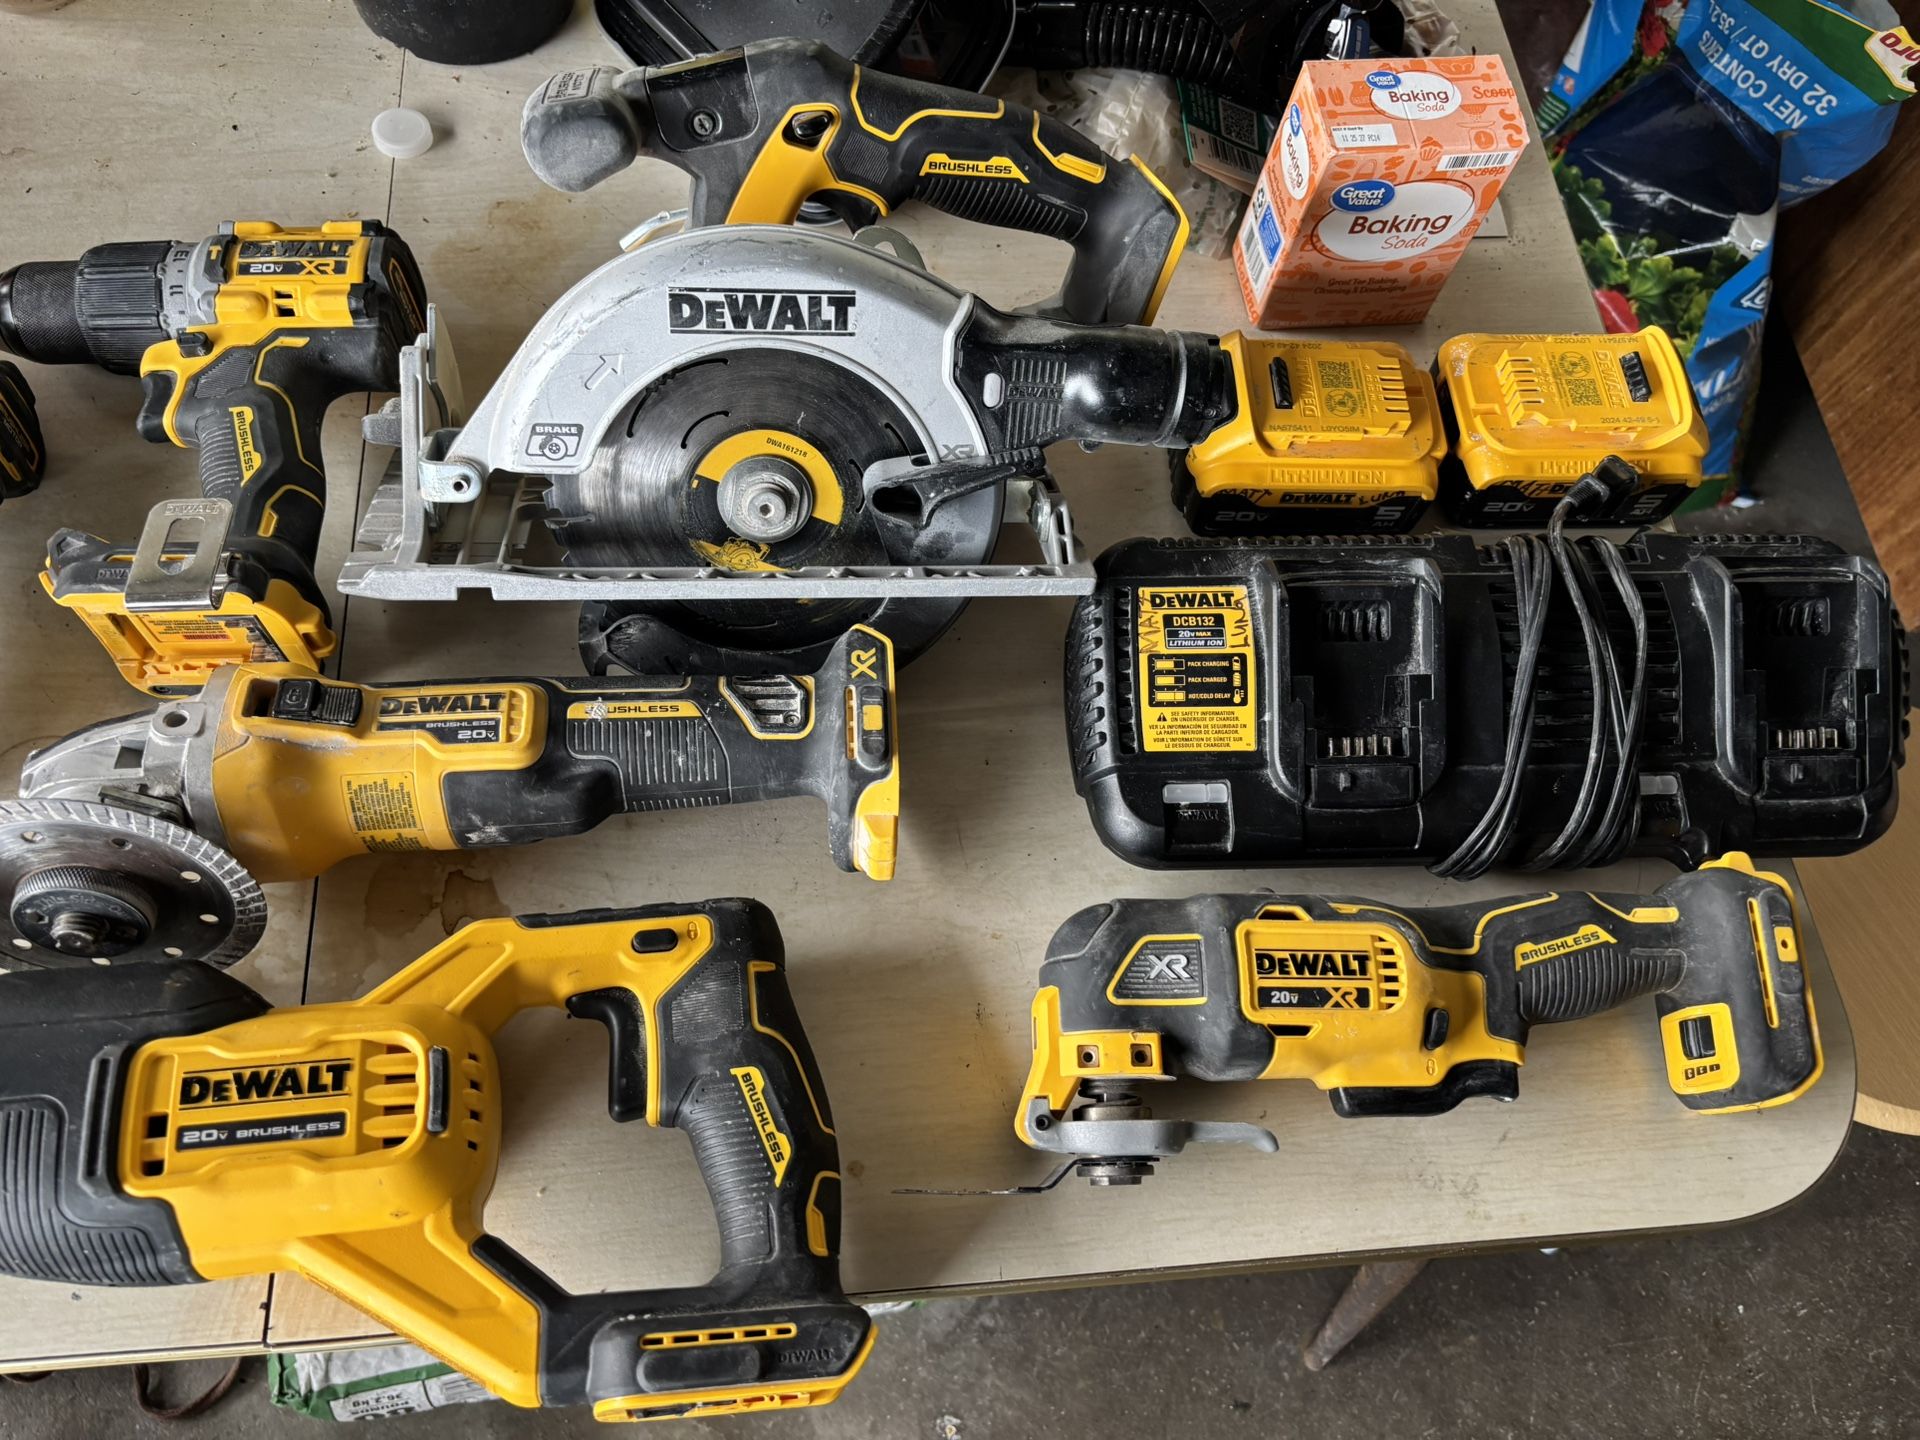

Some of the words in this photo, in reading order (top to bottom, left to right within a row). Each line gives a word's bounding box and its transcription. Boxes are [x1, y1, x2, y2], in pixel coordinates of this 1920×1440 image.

[1739, 34, 1769, 59] QT
[1369, 73, 1394, 83] Great
[1766, 54, 1810, 91] DRY
[1389, 90, 1449, 103] Baking
[1472, 86, 1515, 99] Scoop
[1802, 83, 1838, 116] 32
[1417, 103, 1445, 113] Soda
[1763, 94, 1809, 130] NET
[928, 161, 1012, 174] BRUSHLESS
[1286, 133, 1303, 188] Baking
[1340, 187, 1386, 200] Great
[1348, 196, 1384, 207] Value
[1348, 214, 1453, 235] Baking
[240, 241, 353, 257] DEWALT
[1381, 233, 1428, 250] Soda
[173, 250, 189, 262] 13
[299, 261, 335, 275] XR
[170, 284, 184, 296] 11
[668, 293, 857, 331] DEWALT
[535, 425, 578, 434] BRAKE
[236, 411, 254, 472] BRUSHLESS
[766, 436, 808, 458] DWA161218
[1271, 469, 1348, 485] LITHIUM
[1351, 470, 1386, 485] ION
[1280, 493, 1356, 504] DEWALT
[1374, 506, 1405, 520] 5
[1150, 593, 1234, 608] DEWALT
[1173, 616, 1215, 626] DCB132
[850, 648, 877, 680] XR
[380, 694, 506, 715] DEWALT
[585, 704, 680, 714] USHLESS
[1521, 931, 1600, 961] BRUSHLESS
[1148, 955, 1192, 981] XR
[1255, 953, 1370, 976] DEWALT
[1325, 988, 1358, 1009] XR
[180, 1063, 353, 1105] DEWALT
[742, 1072, 785, 1163] BRUSHLESS
[236, 1121, 341, 1139] BRUSHLESS
